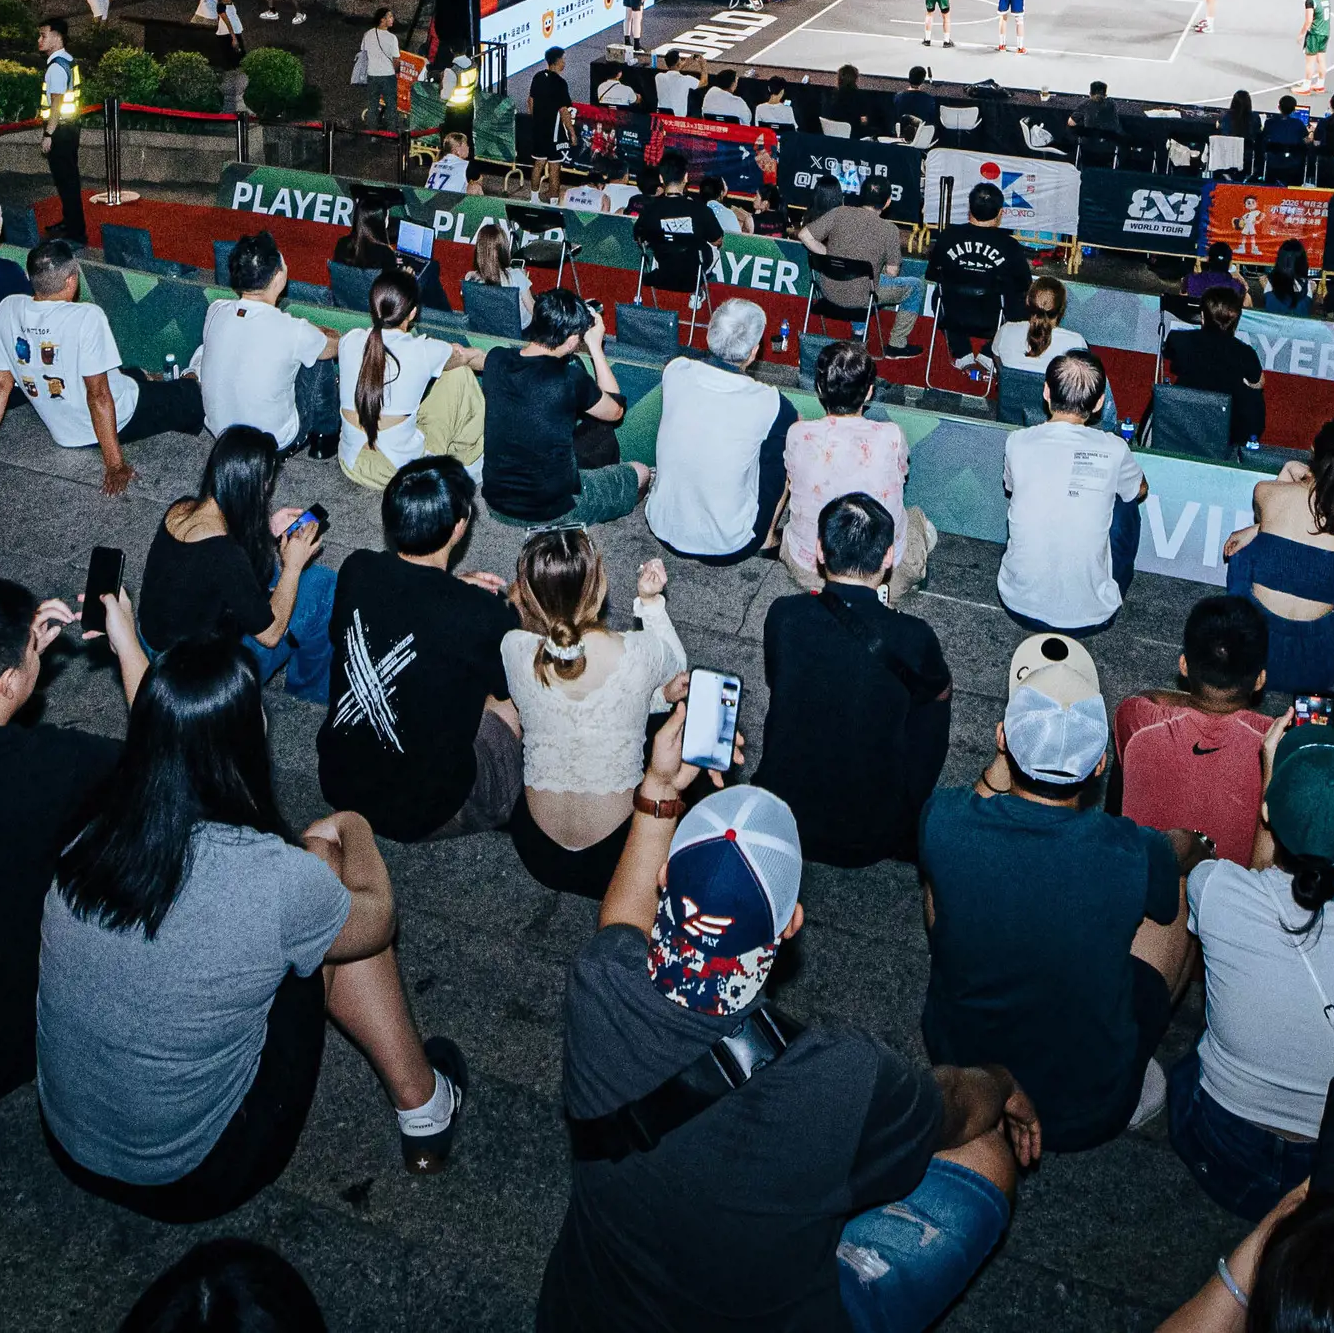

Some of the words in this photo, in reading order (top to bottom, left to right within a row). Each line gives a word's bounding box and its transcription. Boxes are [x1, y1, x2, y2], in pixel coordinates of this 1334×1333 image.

[652, 10, 779, 60] ORLD
[427, 172, 451, 191] 47
[233, 180, 356, 227] PLAYER
[1129, 222, 1159, 233] WORLD
[1161, 225, 1185, 235] TOUR
[946, 241, 1006, 267] NAUTICA
[712, 250, 800, 296] AYER
[701, 934, 720, 948] FLY
